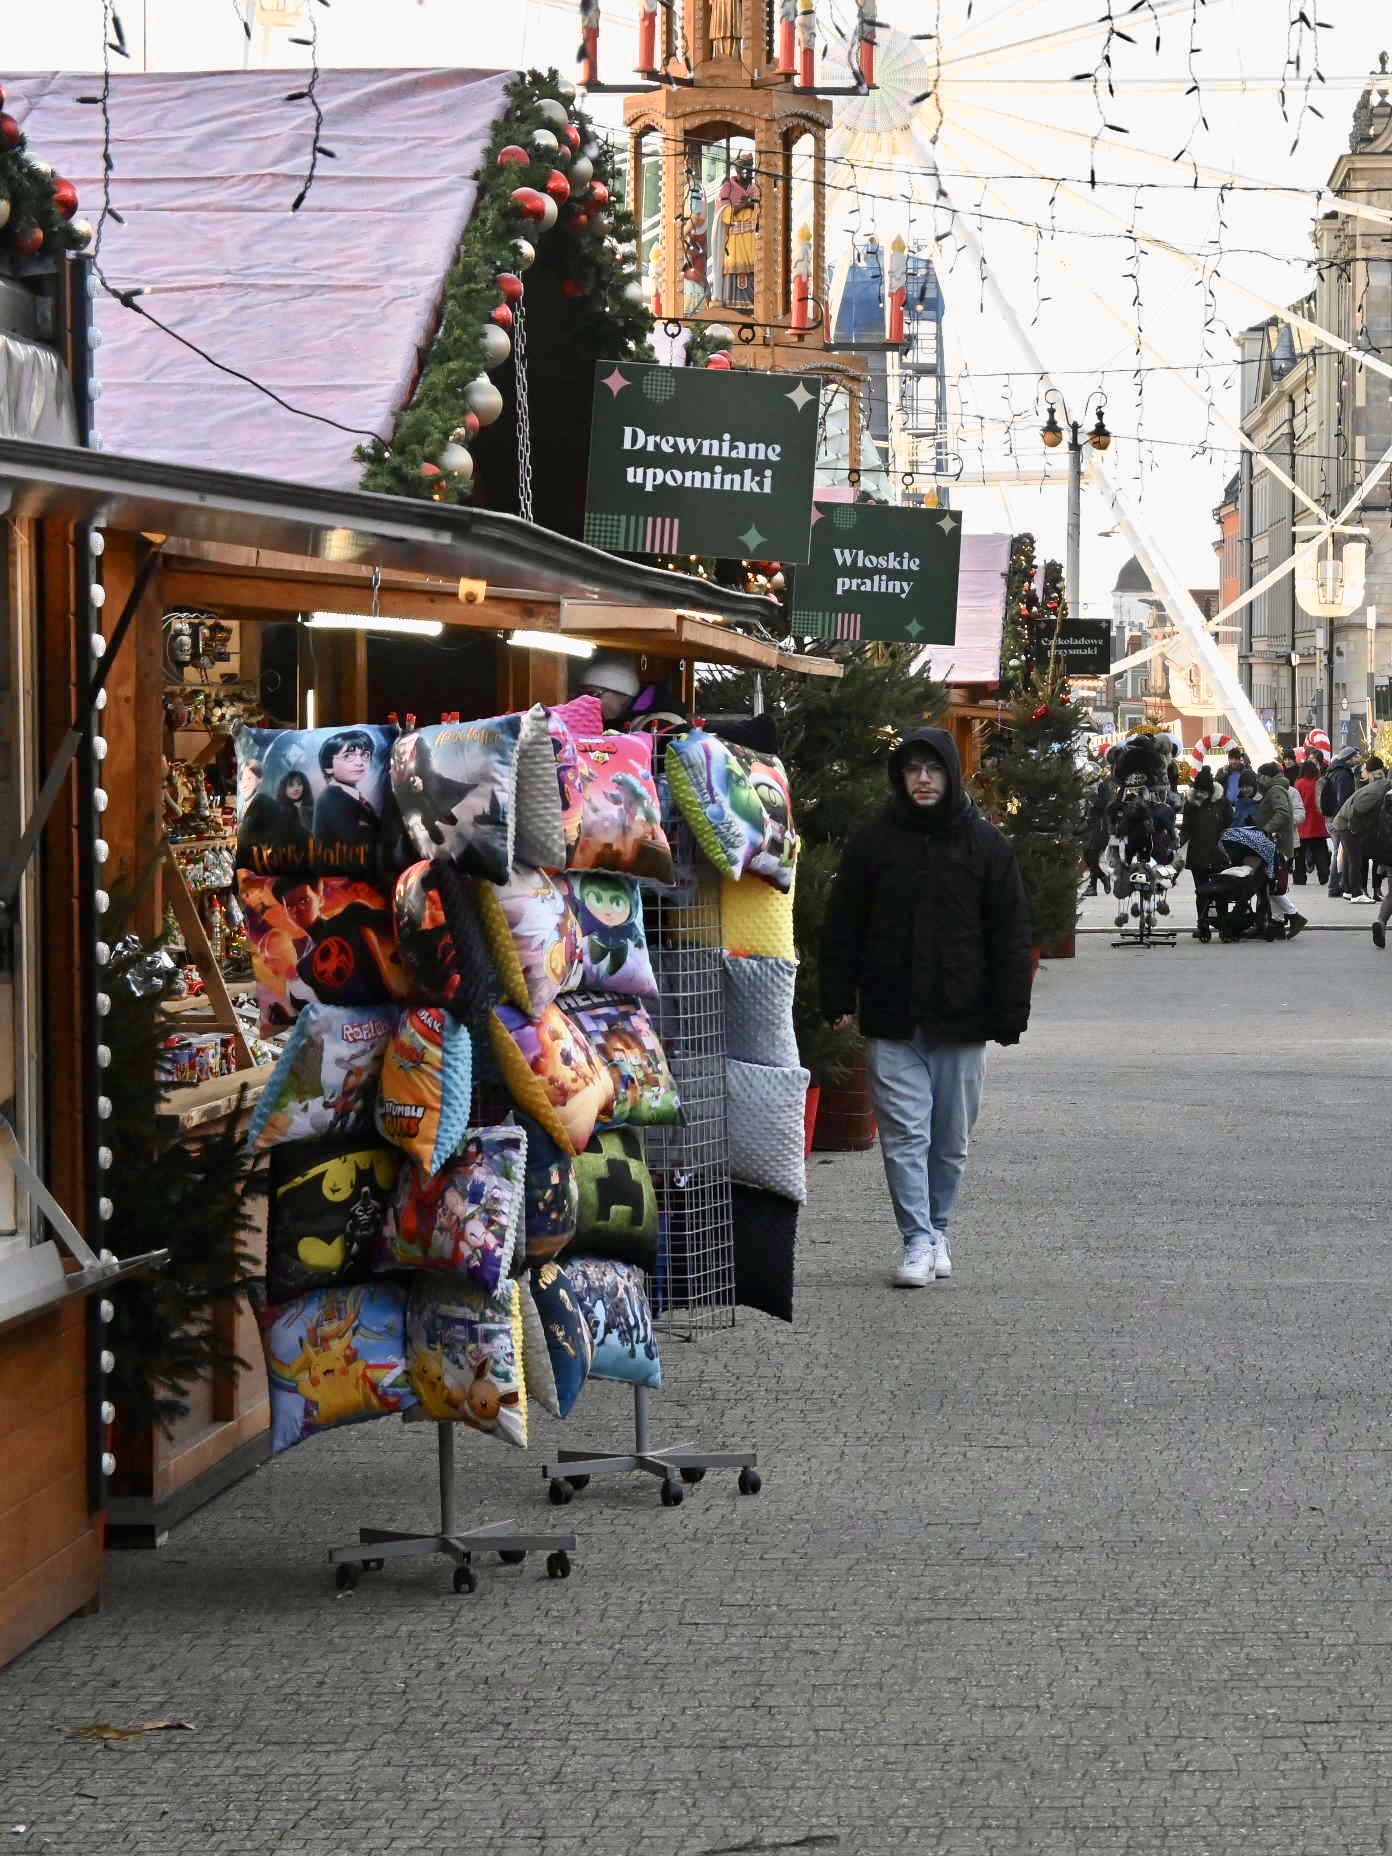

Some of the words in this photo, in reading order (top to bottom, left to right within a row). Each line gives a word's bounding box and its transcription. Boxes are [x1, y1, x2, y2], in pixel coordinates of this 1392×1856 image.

[623, 425, 782, 463] Drewniane
[626, 462, 774, 496] upominki
[833, 548, 920, 572] Włoskie
[837, 575, 914, 601] praliny
